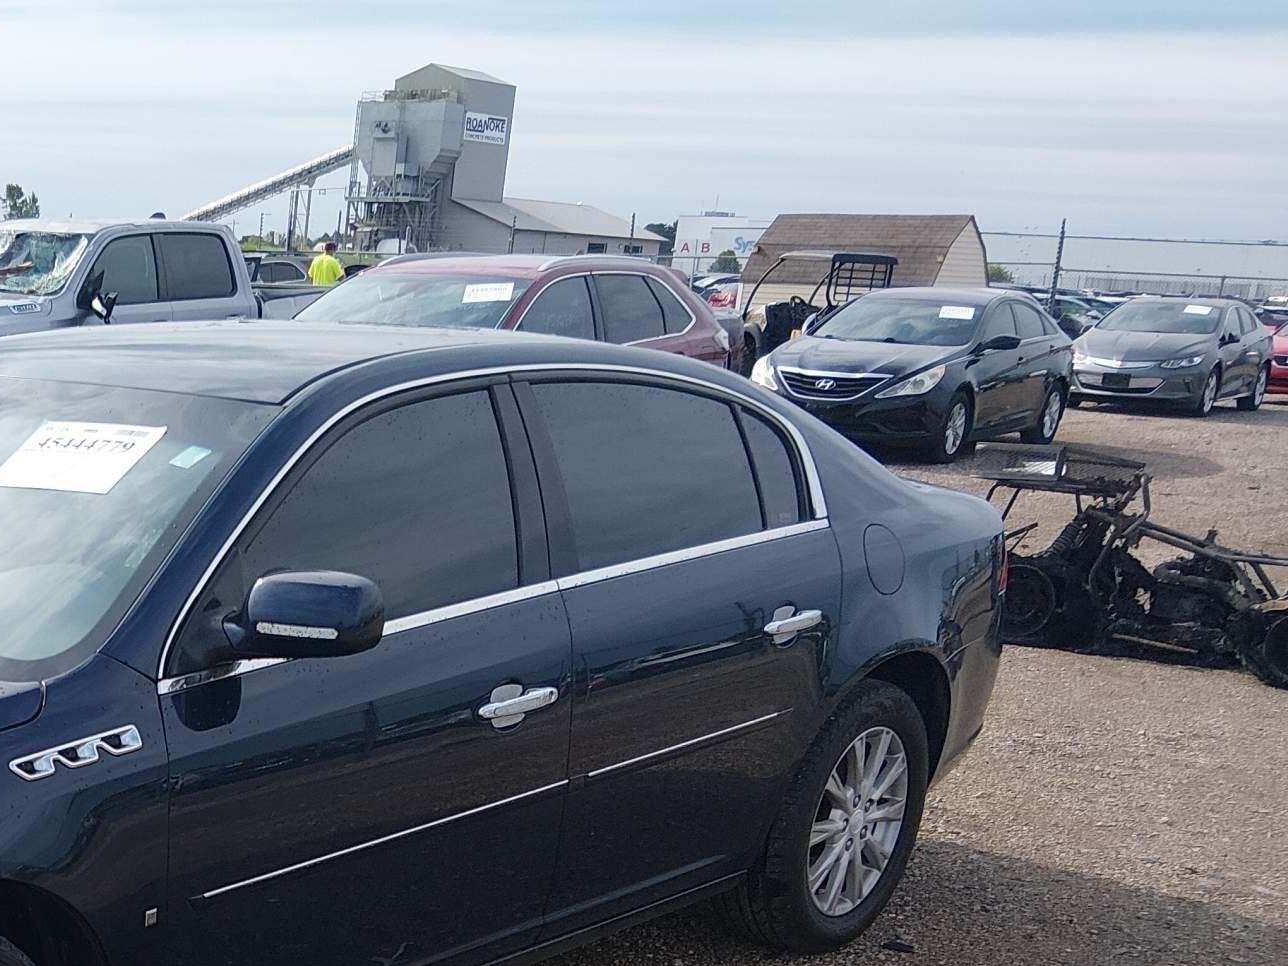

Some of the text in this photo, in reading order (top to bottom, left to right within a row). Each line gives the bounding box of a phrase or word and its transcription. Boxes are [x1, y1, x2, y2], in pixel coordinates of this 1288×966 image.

[466, 117, 506, 133] ROANOKE
[681, 242, 711, 253] A B
[38, 437, 136, 452] 45444779
